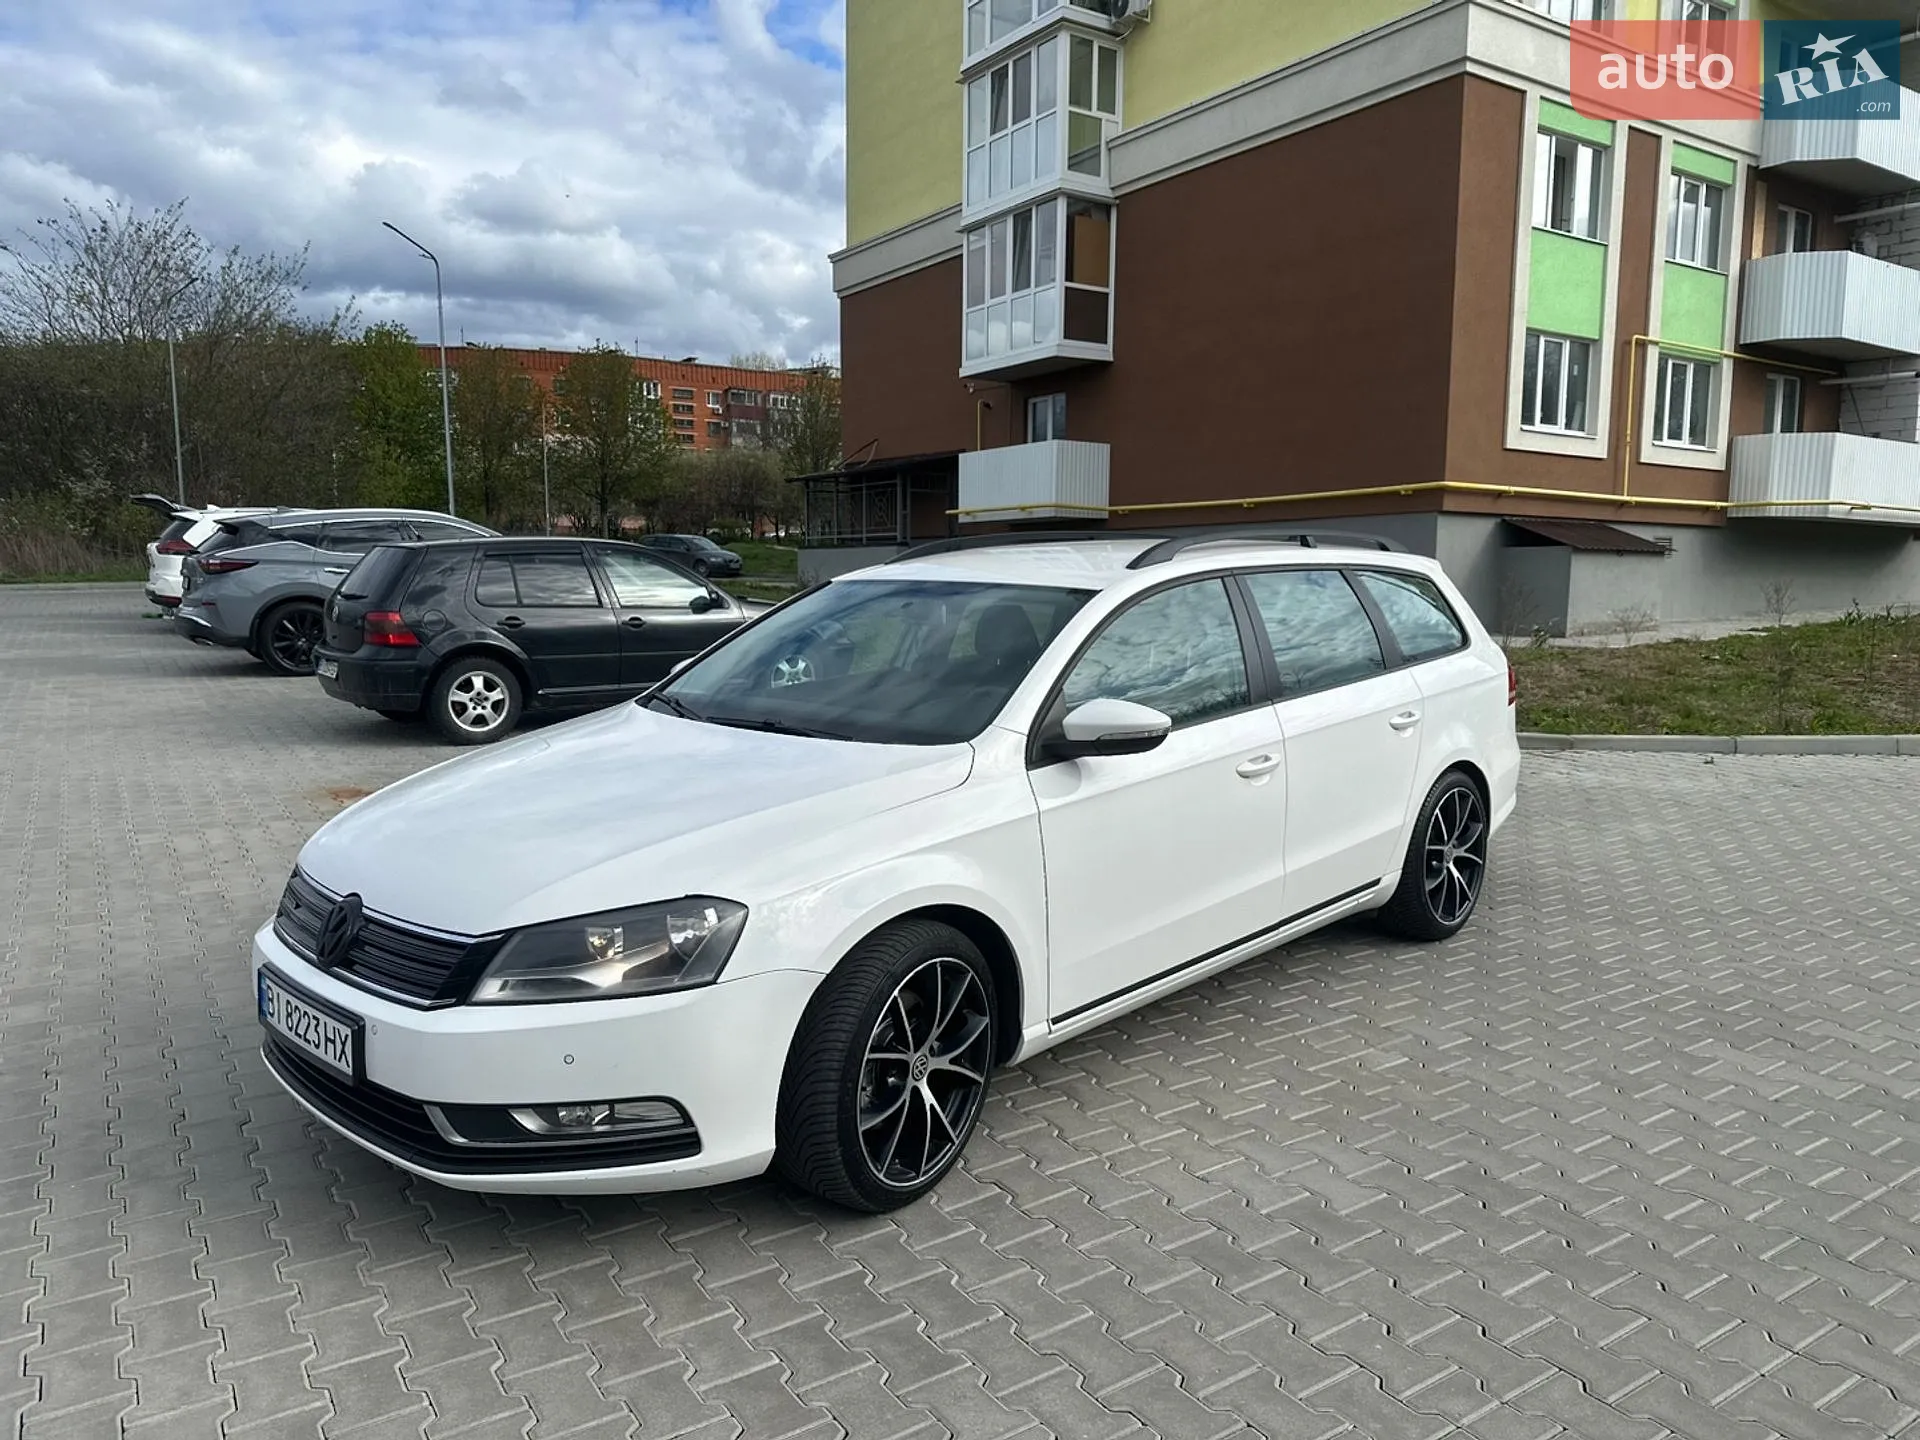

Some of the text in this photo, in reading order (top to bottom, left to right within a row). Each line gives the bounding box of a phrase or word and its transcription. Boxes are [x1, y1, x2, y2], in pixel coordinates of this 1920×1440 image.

[266, 983, 351, 1069] BI 8223 HX
